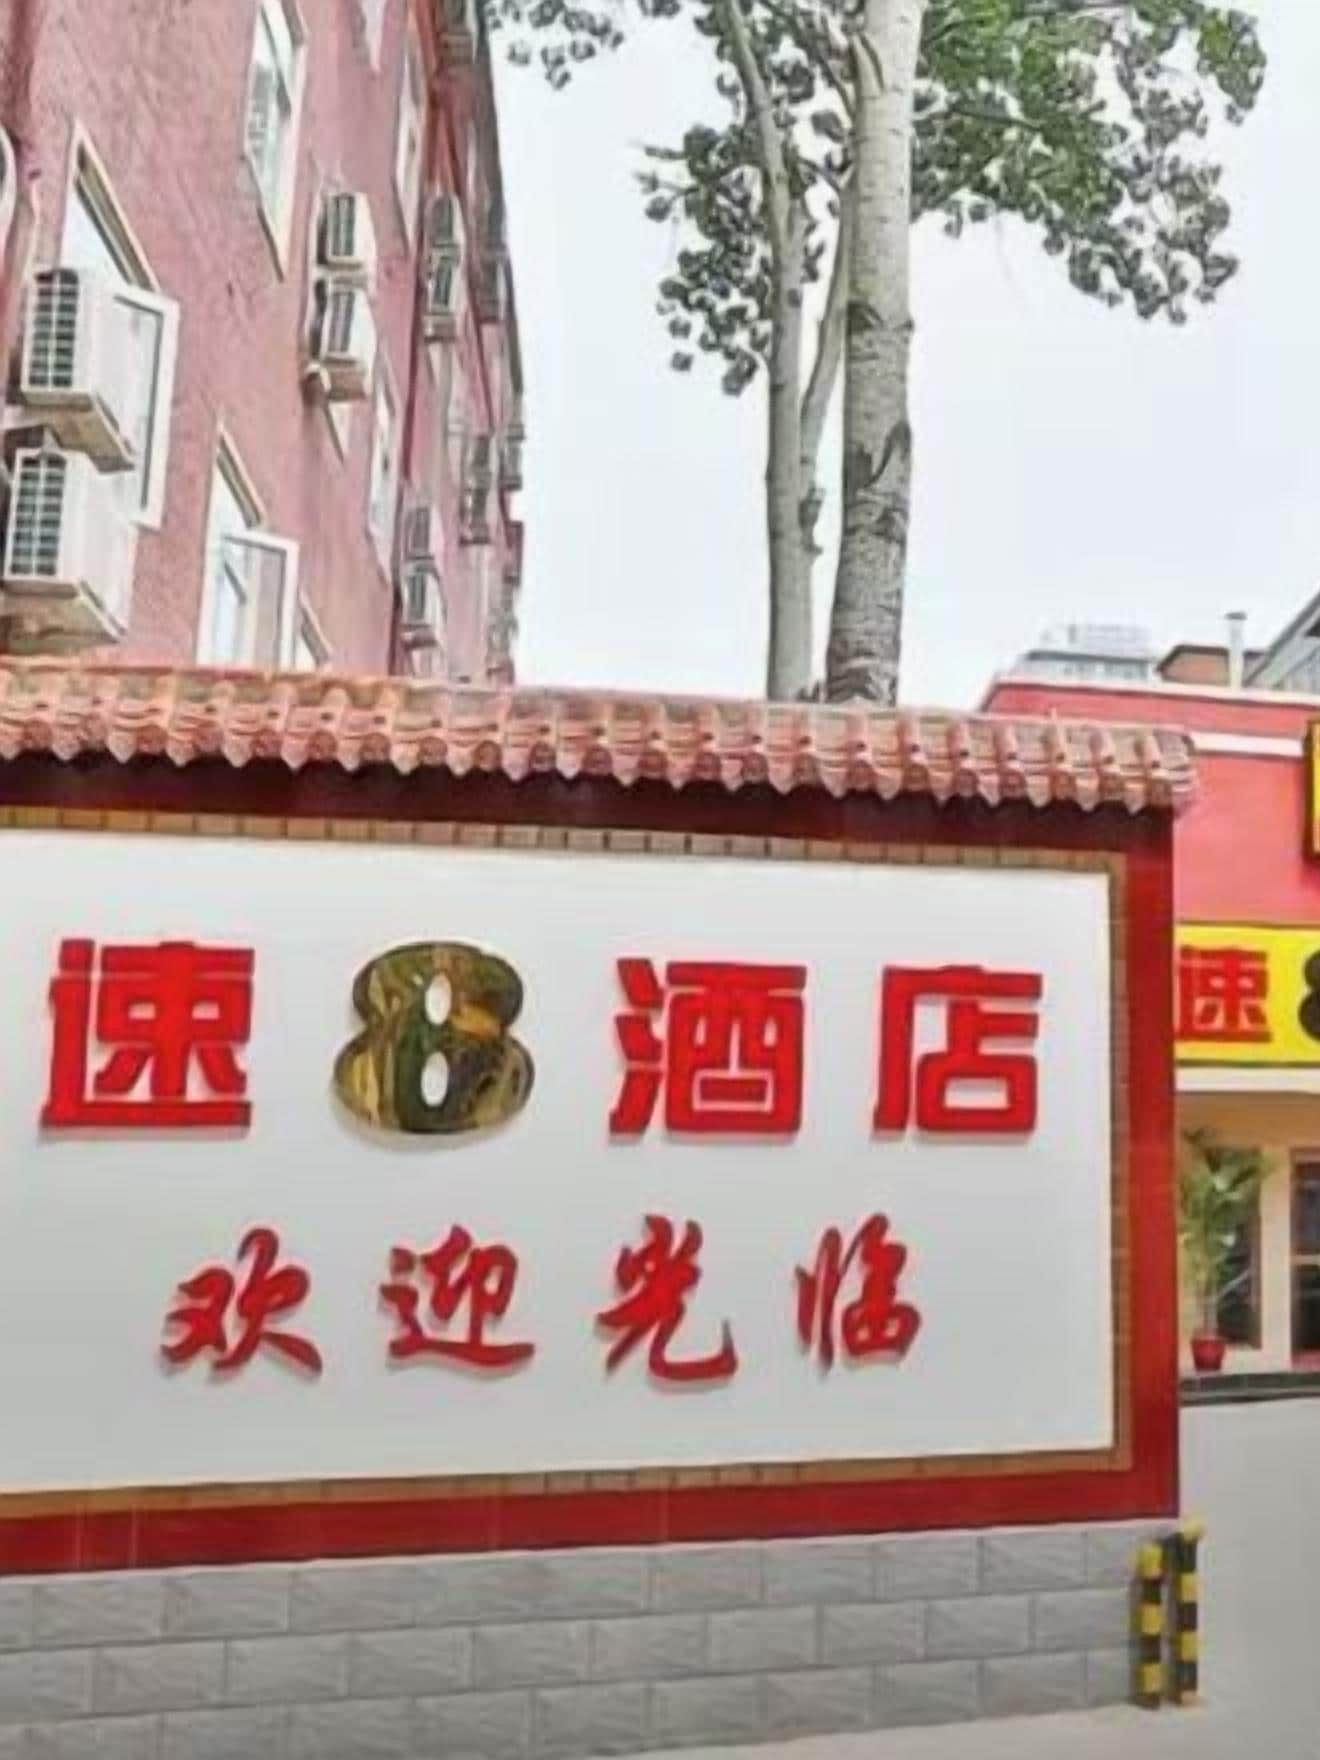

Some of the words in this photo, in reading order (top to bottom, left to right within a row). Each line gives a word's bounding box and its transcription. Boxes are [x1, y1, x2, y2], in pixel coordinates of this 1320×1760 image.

[39, 938, 1042, 1135] 速8酒店
[161, 1215, 923, 1380] 欢迎光临
